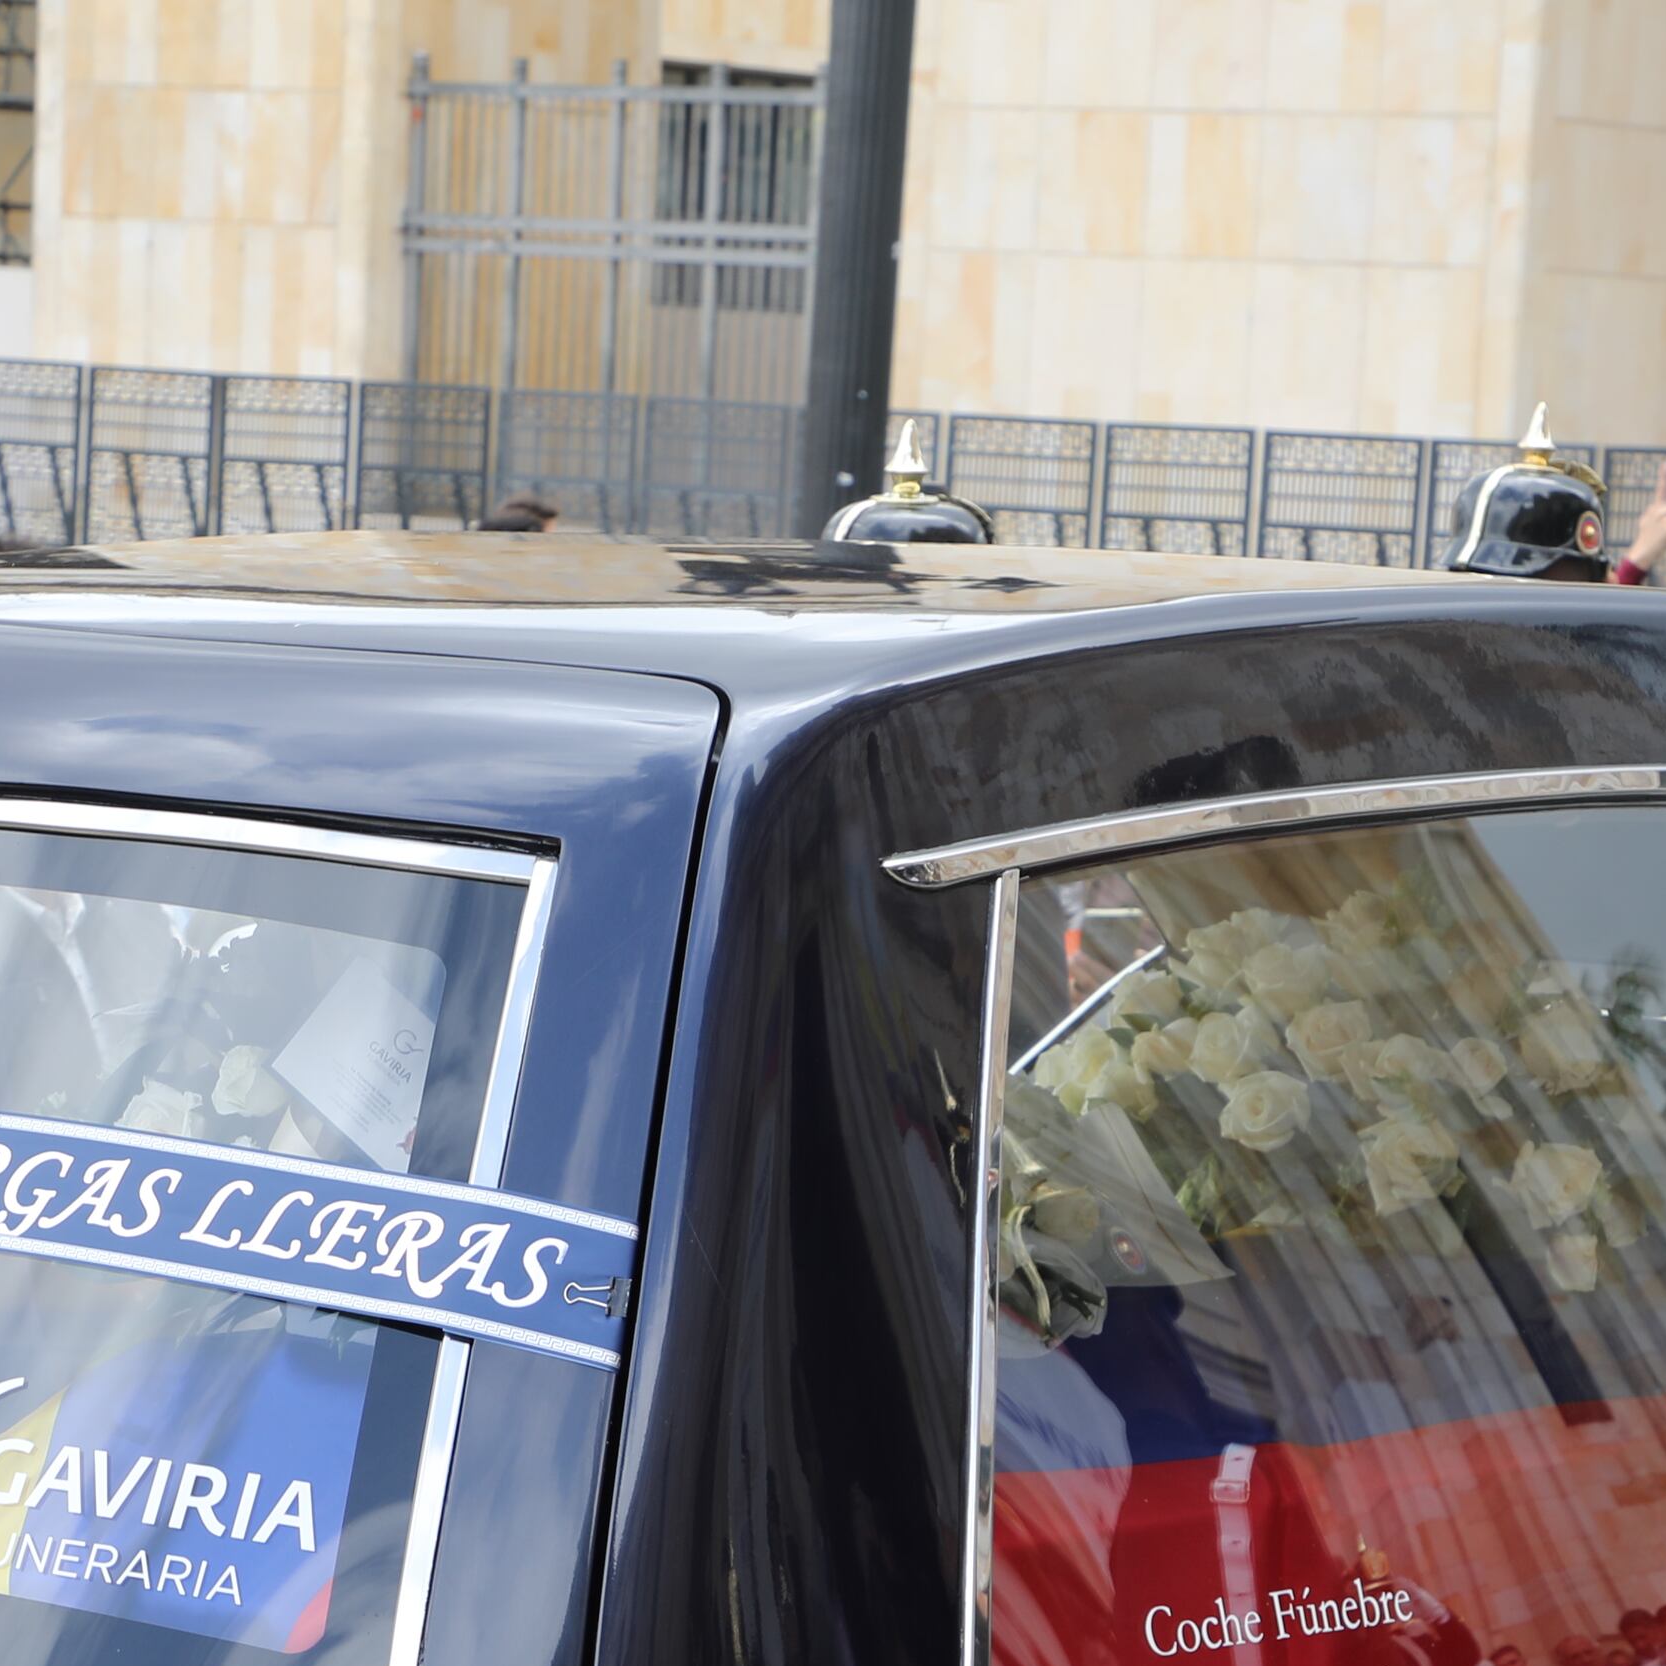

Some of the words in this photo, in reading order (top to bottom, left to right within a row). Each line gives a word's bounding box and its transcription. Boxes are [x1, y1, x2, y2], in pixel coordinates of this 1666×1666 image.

[368, 1040, 413, 1084] GAVIRIA
[179, 1179, 569, 1308] LLERAS
[1144, 1596, 1265, 1657] Coche
[1268, 1578, 1414, 1641] Fúnebre
